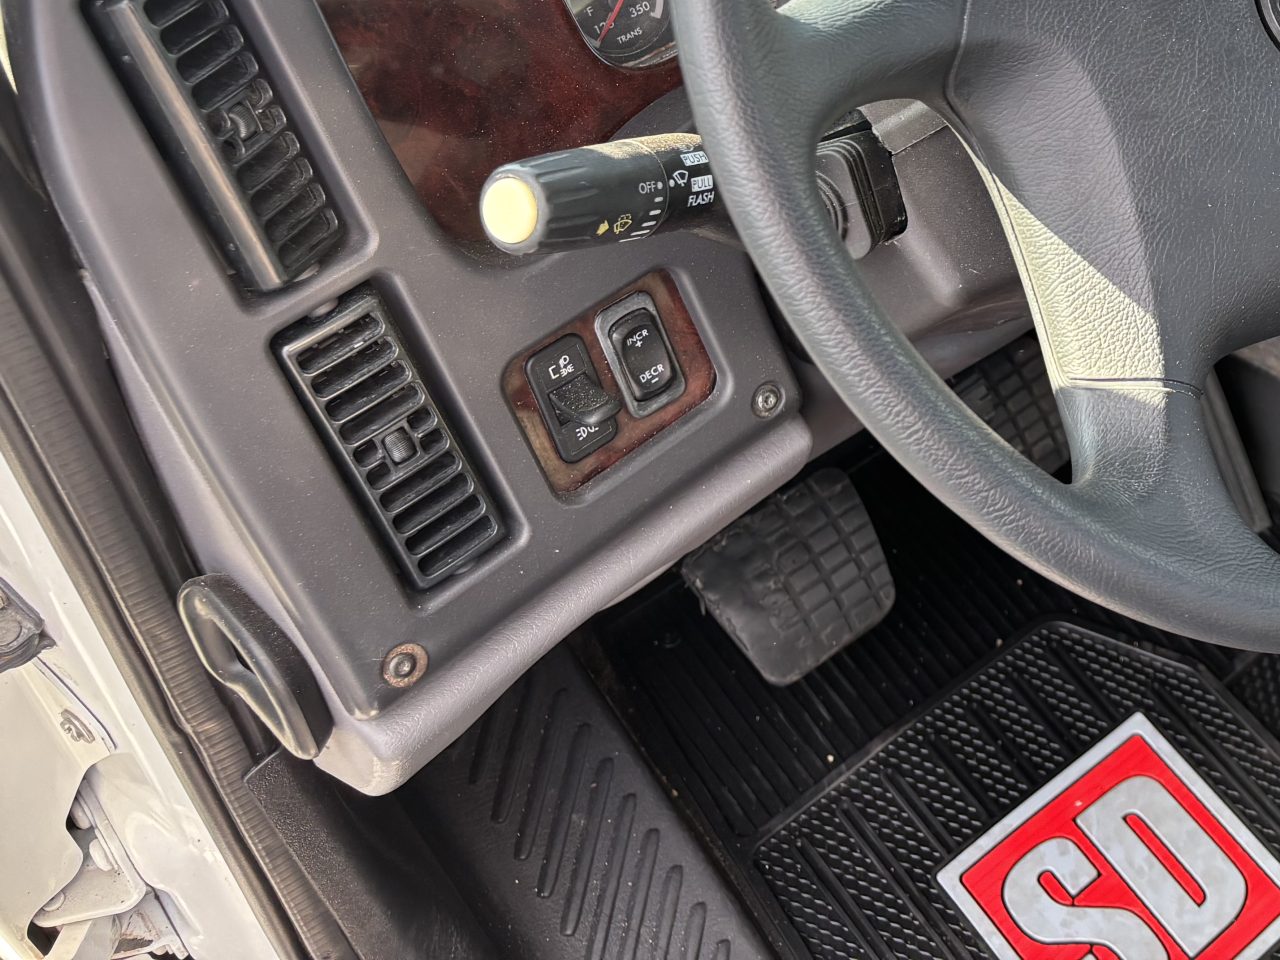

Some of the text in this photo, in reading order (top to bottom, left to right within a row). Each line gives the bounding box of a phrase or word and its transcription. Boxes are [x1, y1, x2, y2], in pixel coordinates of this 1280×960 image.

[629, 1, 651, 18] 350
[616, 27, 643, 44] TRANS
[682, 152, 707, 166] PUSH
[638, 182, 656, 194] OFF
[692, 176, 713, 191] PULL
[688, 192, 715, 208] FLASH
[627, 329, 649, 346] INCR
[639, 364, 665, 384] DECR
[1002, 774, 1249, 960] SD
